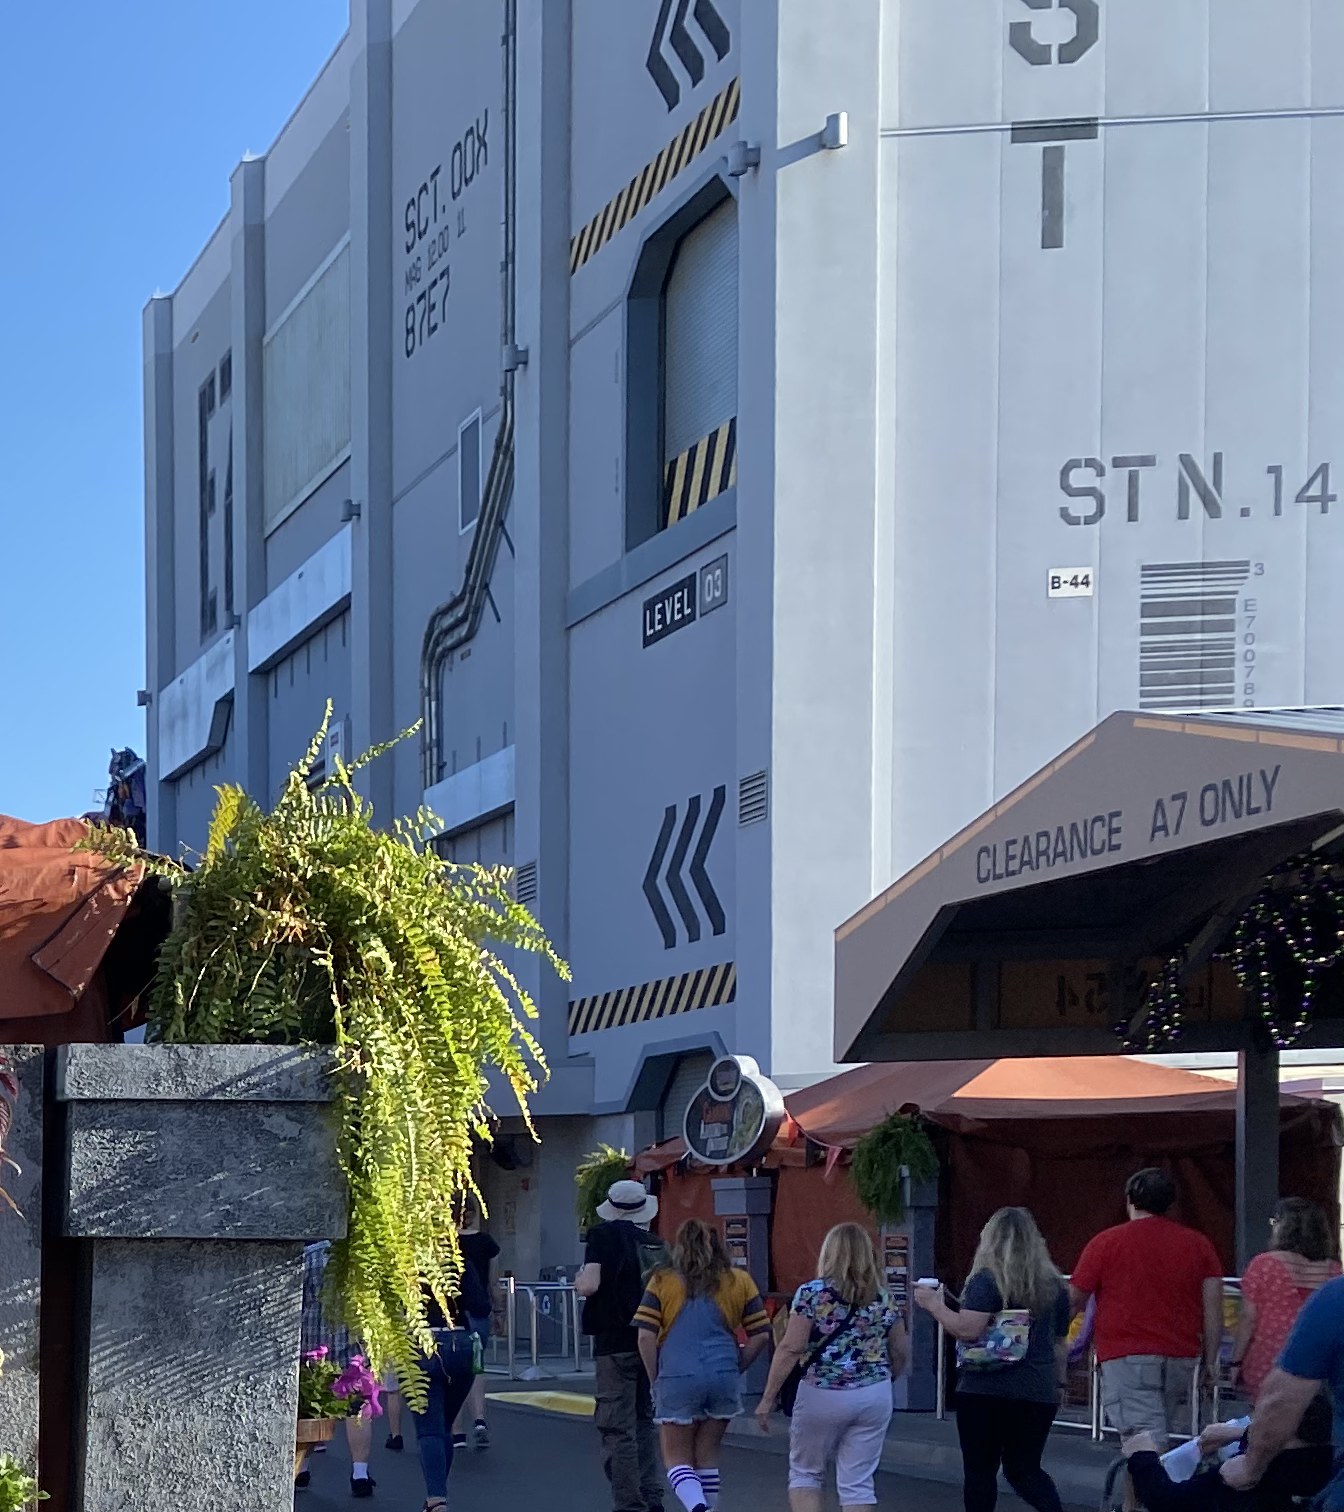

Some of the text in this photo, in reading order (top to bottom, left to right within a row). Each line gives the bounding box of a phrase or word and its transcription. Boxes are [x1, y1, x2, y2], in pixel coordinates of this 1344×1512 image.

[404, 164, 446, 254] SCT.
[646, 568, 722, 637] LEVEL 03
[1050, 574, 1092, 590] B-44
[976, 765, 1282, 884] CLEARANCE A7 ONLY
